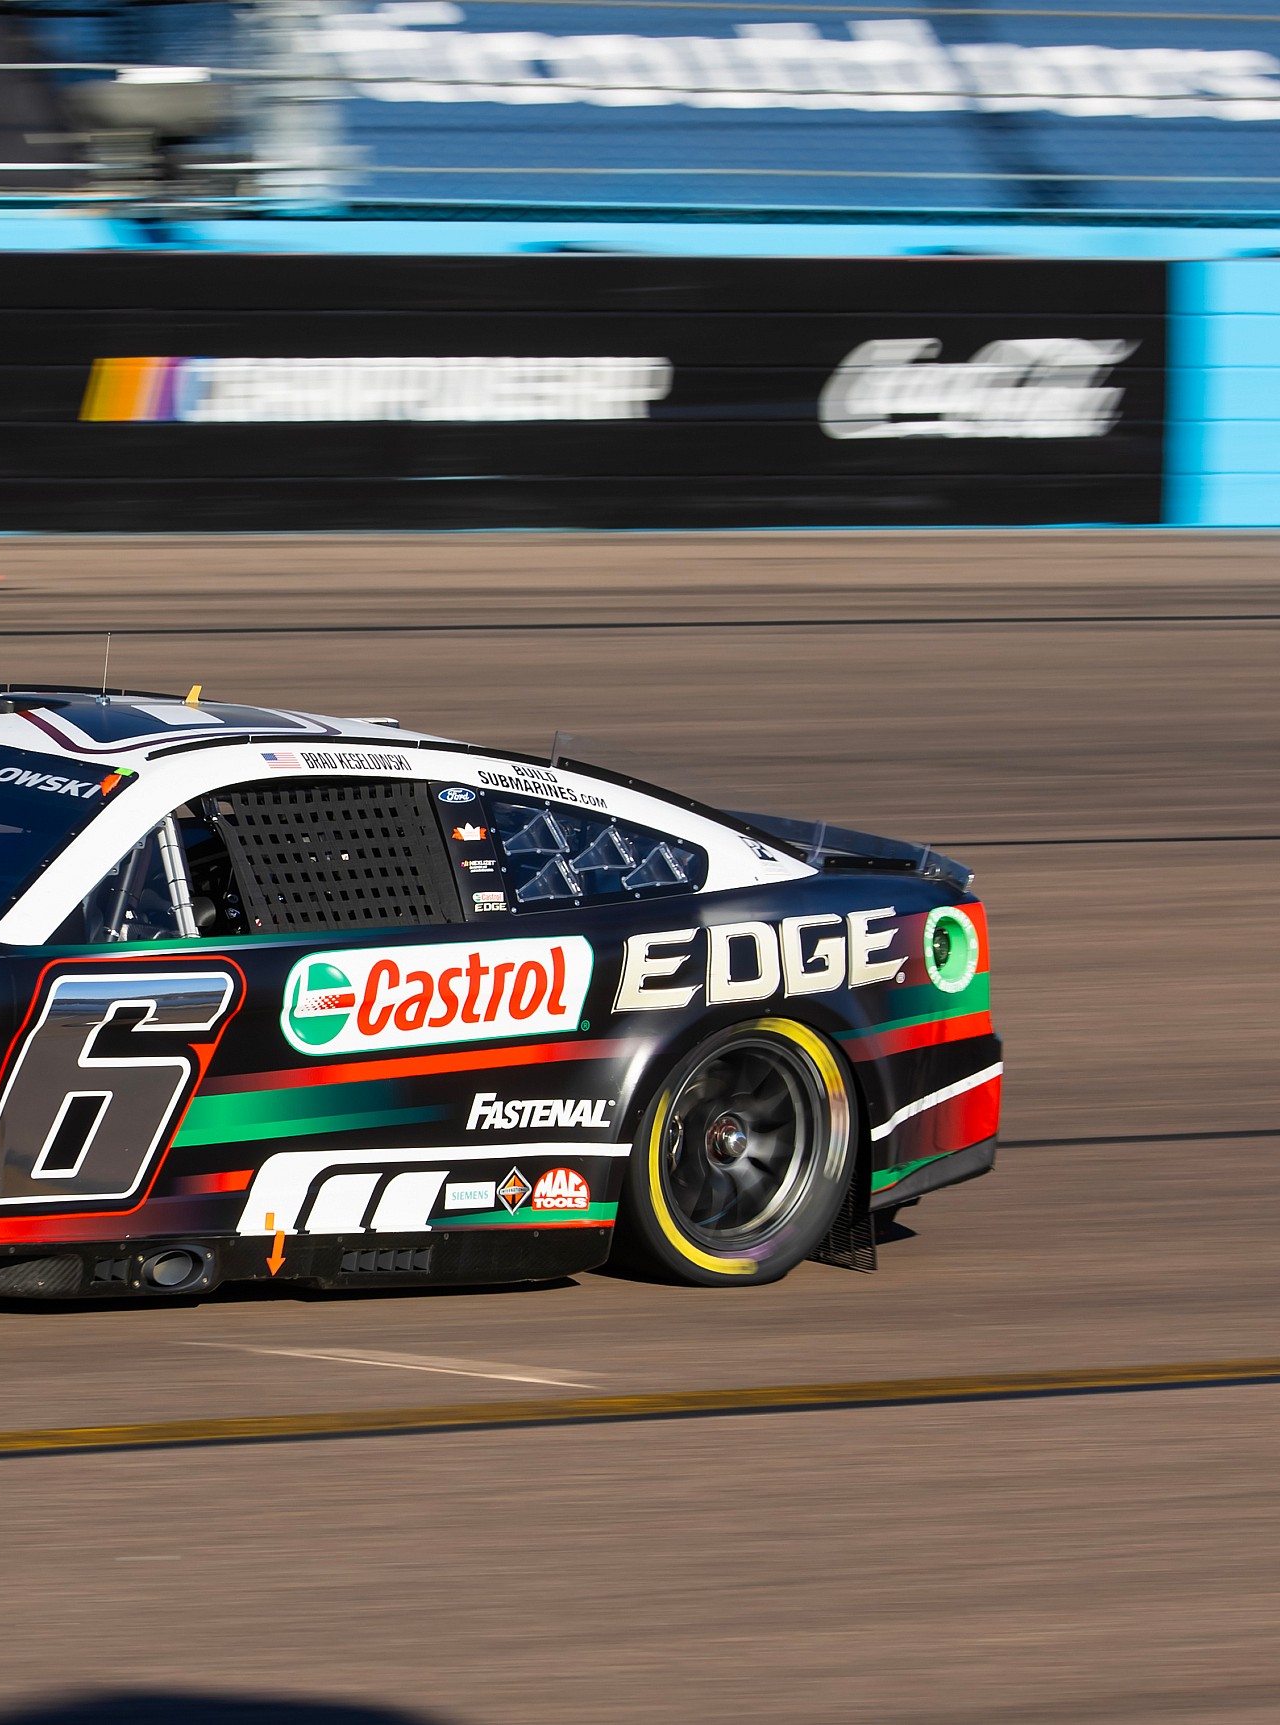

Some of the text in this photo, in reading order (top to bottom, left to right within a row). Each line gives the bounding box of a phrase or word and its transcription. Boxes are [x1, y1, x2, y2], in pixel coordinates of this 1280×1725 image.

[300, 752, 412, 771] BRAD KESELOWSKI
[512, 765, 558, 783] BUILD
[445, 789, 470, 801] Ford
[477, 770, 608, 809] SUBMARINES.COM
[481, 893, 502, 901] Castrol
[474, 902, 507, 912] EDGE
[610, 906, 909, 1014] EDGE
[357, 946, 567, 1035] Castrol
[534, 1169, 588, 1198] MAC
[451, 1190, 489, 1200] SIEMENS
[533, 1198, 587, 1208] TOOLS
